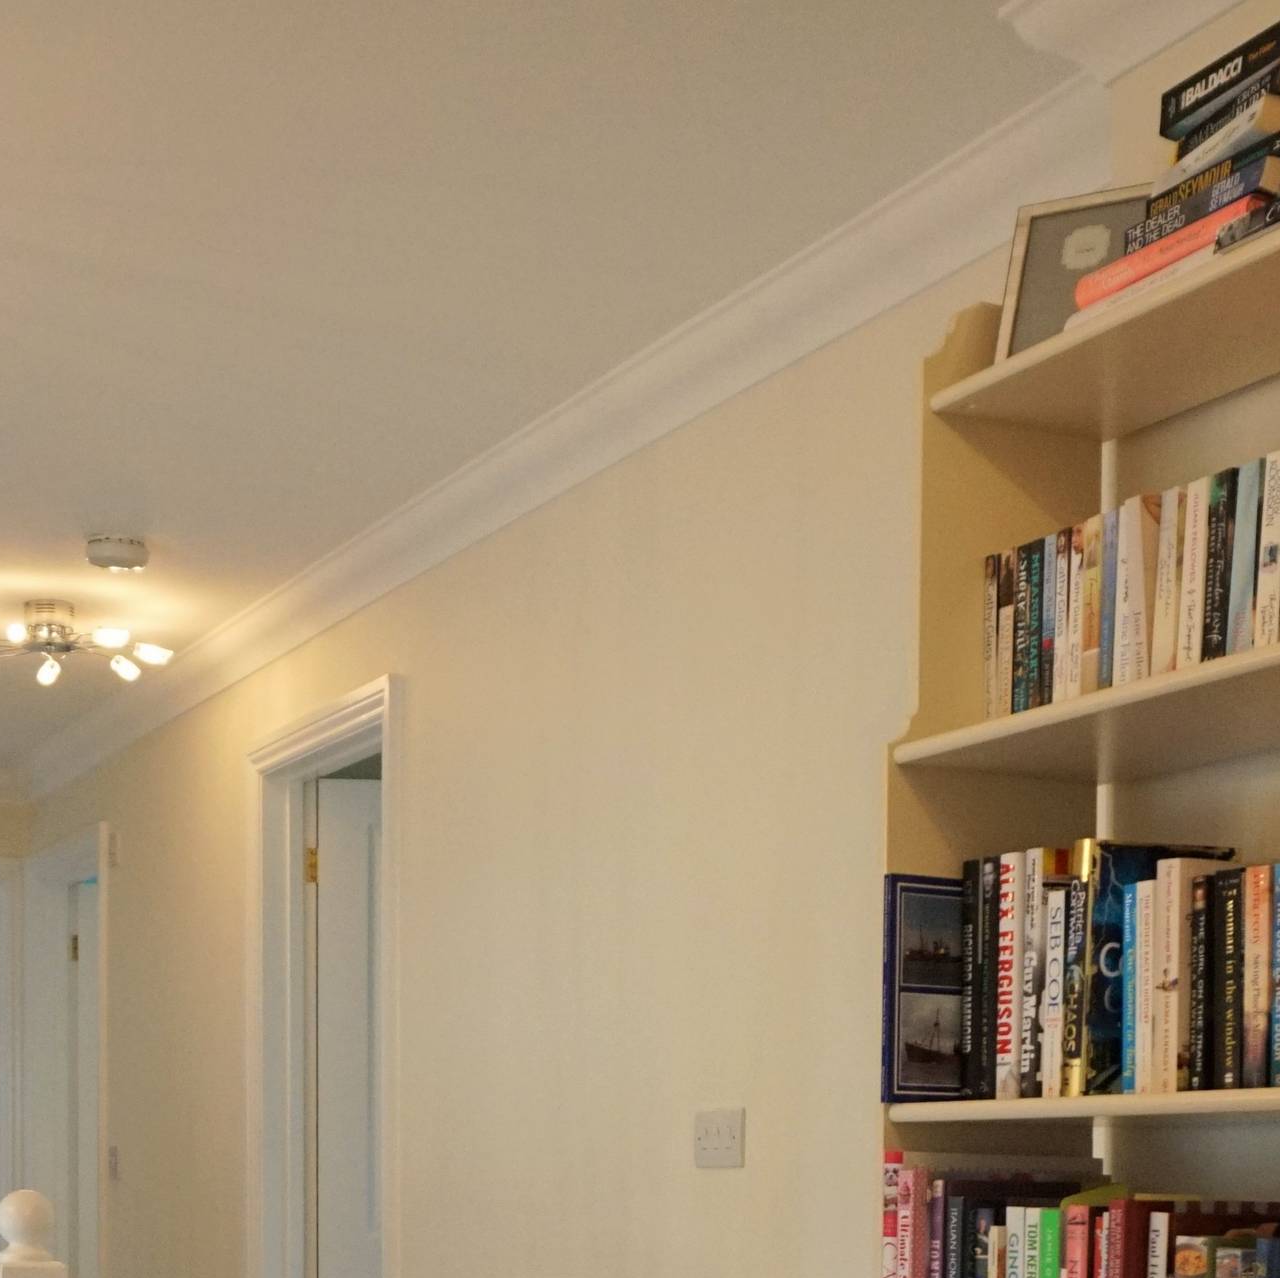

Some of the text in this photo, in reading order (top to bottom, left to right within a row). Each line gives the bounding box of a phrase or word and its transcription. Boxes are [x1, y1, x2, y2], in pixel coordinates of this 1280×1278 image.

[1186, 56, 1243, 107] BALDACCI
[1178, 160, 1233, 200] SEYMOUR
[1126, 214, 1187, 255] AND THE DEAD
[1127, 205, 1182, 244] THE DEALER
[1016, 560, 1029, 613] SHOCK
[1027, 554, 1042, 681] MIRANDA HART
[1055, 604, 1067, 639] Glass
[1204, 611, 1223, 648] Wife
[1119, 644, 1131, 684] Fallon
[1134, 641, 1146, 681] Fallon
[1048, 905, 1062, 951] SEB
[1067, 879, 1081, 956] Cornwell
[1073, 890, 1086, 944] Patricia
[1225, 899, 1236, 954] woman
[996, 862, 1017, 1055] ALEX FERGUSON
[1225, 960, 1237, 974] in
[960, 923, 974, 1054] RICHARD HAMMOND
[1047, 956, 1062, 1015] COE
[1194, 913, 1206, 1072] THE GIRL ON THE TRAIN
[1224, 978, 1236, 1003] the
[1020, 950, 1039, 1073] Guy Martin
[1063, 982, 1078, 1053] CHAOS
[1223, 1008, 1236, 1068] window
[898, 1213, 911, 1270] Ultimate
[949, 1207, 959, 1250] ITALIAN
[1026, 1222, 1039, 1253] TOM
[1150, 1228, 1161, 1260] Paul
